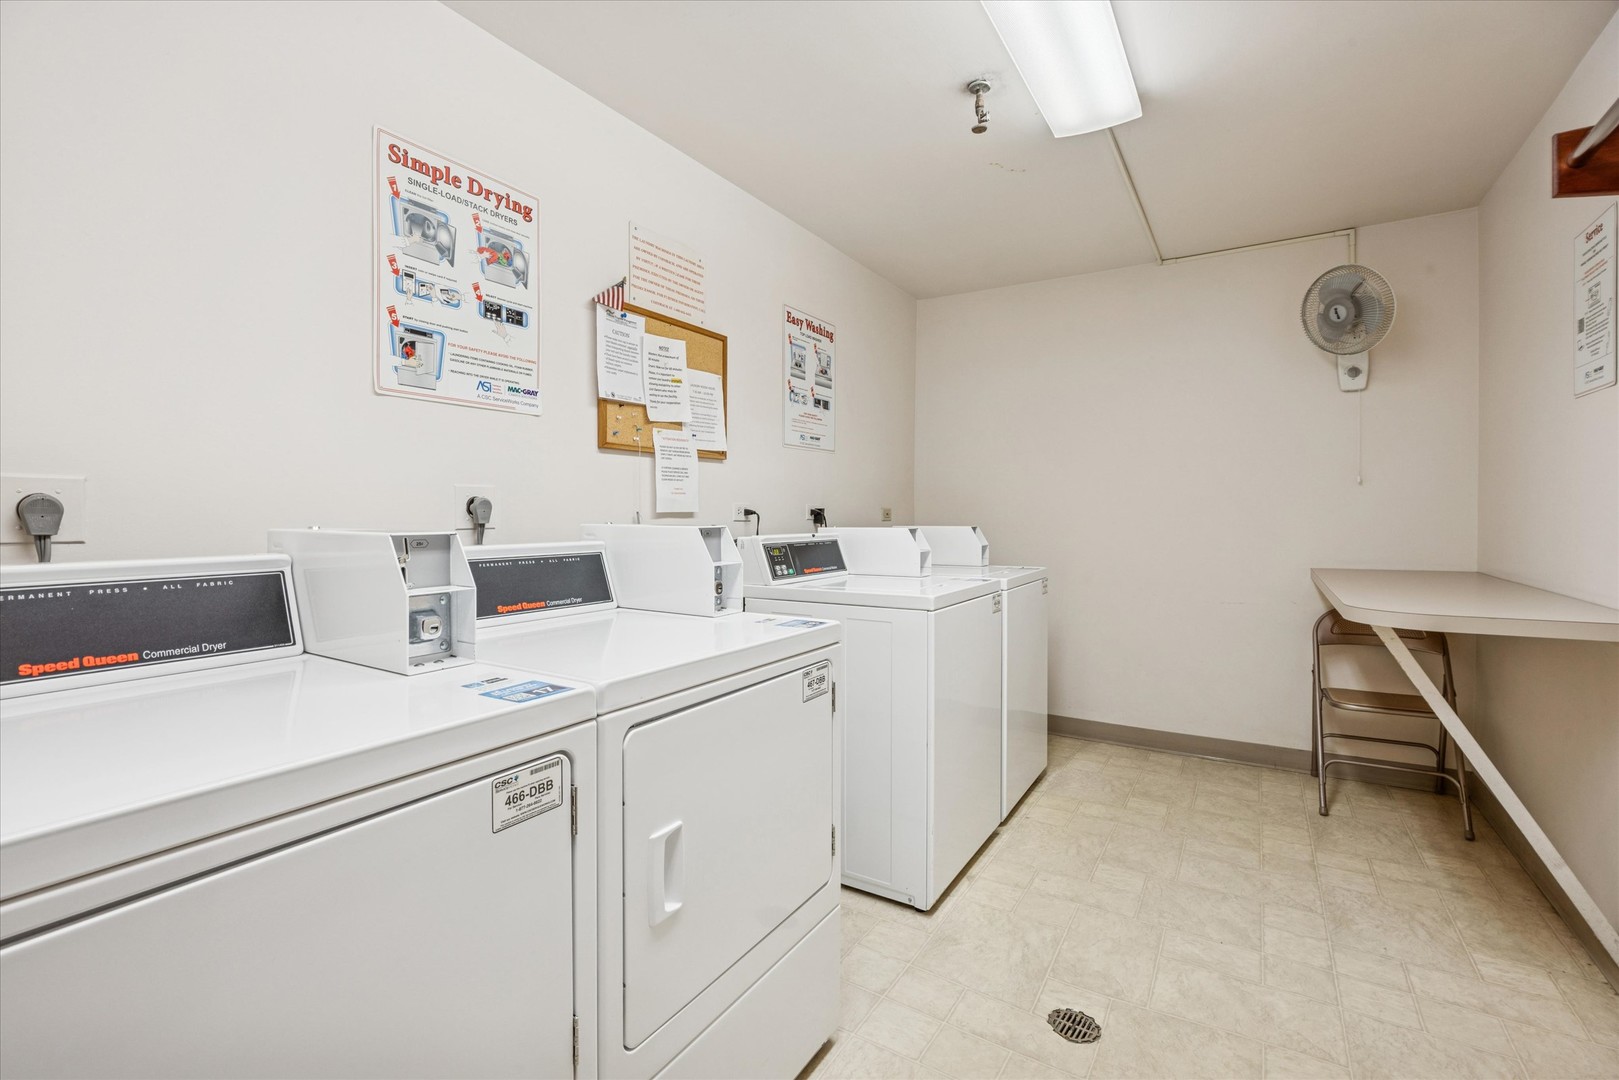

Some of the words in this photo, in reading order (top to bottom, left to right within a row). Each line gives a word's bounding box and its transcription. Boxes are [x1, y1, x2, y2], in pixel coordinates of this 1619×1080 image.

[388, 143, 462, 189] Simple
[467, 175, 533, 223] Drying
[407, 176, 488, 214] SINGLE-LOAD/STACK
[490, 208, 518, 226] DRYERS
[1585, 223, 1603, 244] Service
[786, 311, 804, 331] Easy
[805, 318, 834, 343] Washing
[0, 591, 72, 601] ERMANENT
[89, 587, 129, 595] PRESS
[497, 603, 522, 614] Speed
[522, 601, 546, 610] Queen
[546, 598, 570, 607] Commercial
[18, 656, 80, 677] Speed
[82, 651, 139, 667] Queen
[142, 644, 200, 660] Commercial
[202, 641, 227, 653] Dryer
[532, 686, 555, 695] 17
[494, 777, 513, 789] CSC
[504, 779, 554, 807] 466-DBB
